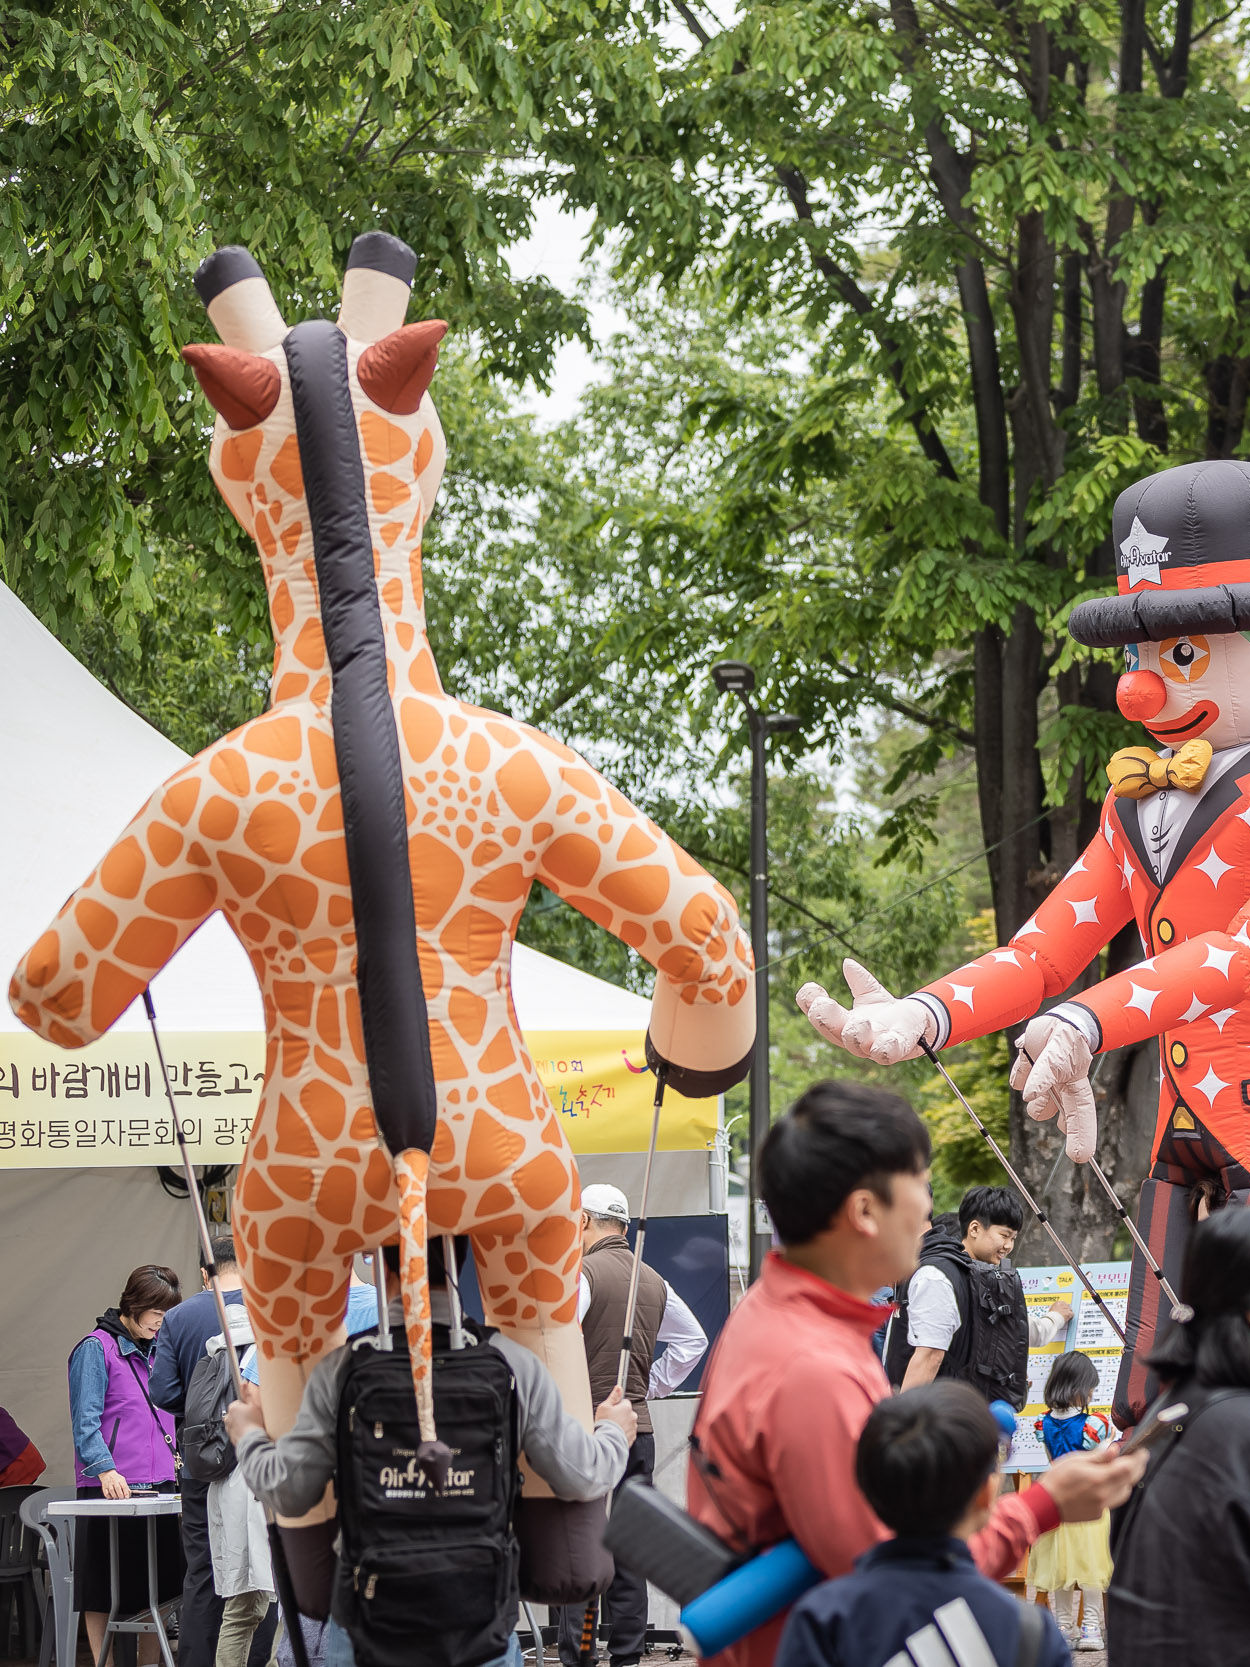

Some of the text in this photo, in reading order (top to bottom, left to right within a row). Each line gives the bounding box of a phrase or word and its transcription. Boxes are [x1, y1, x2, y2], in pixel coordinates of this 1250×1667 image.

[32, 1062, 150, 1098] 바람개비
[0, 1119, 202, 1148] 평화통일자문회의
[1098, 1272, 1127, 1284] 부모님
